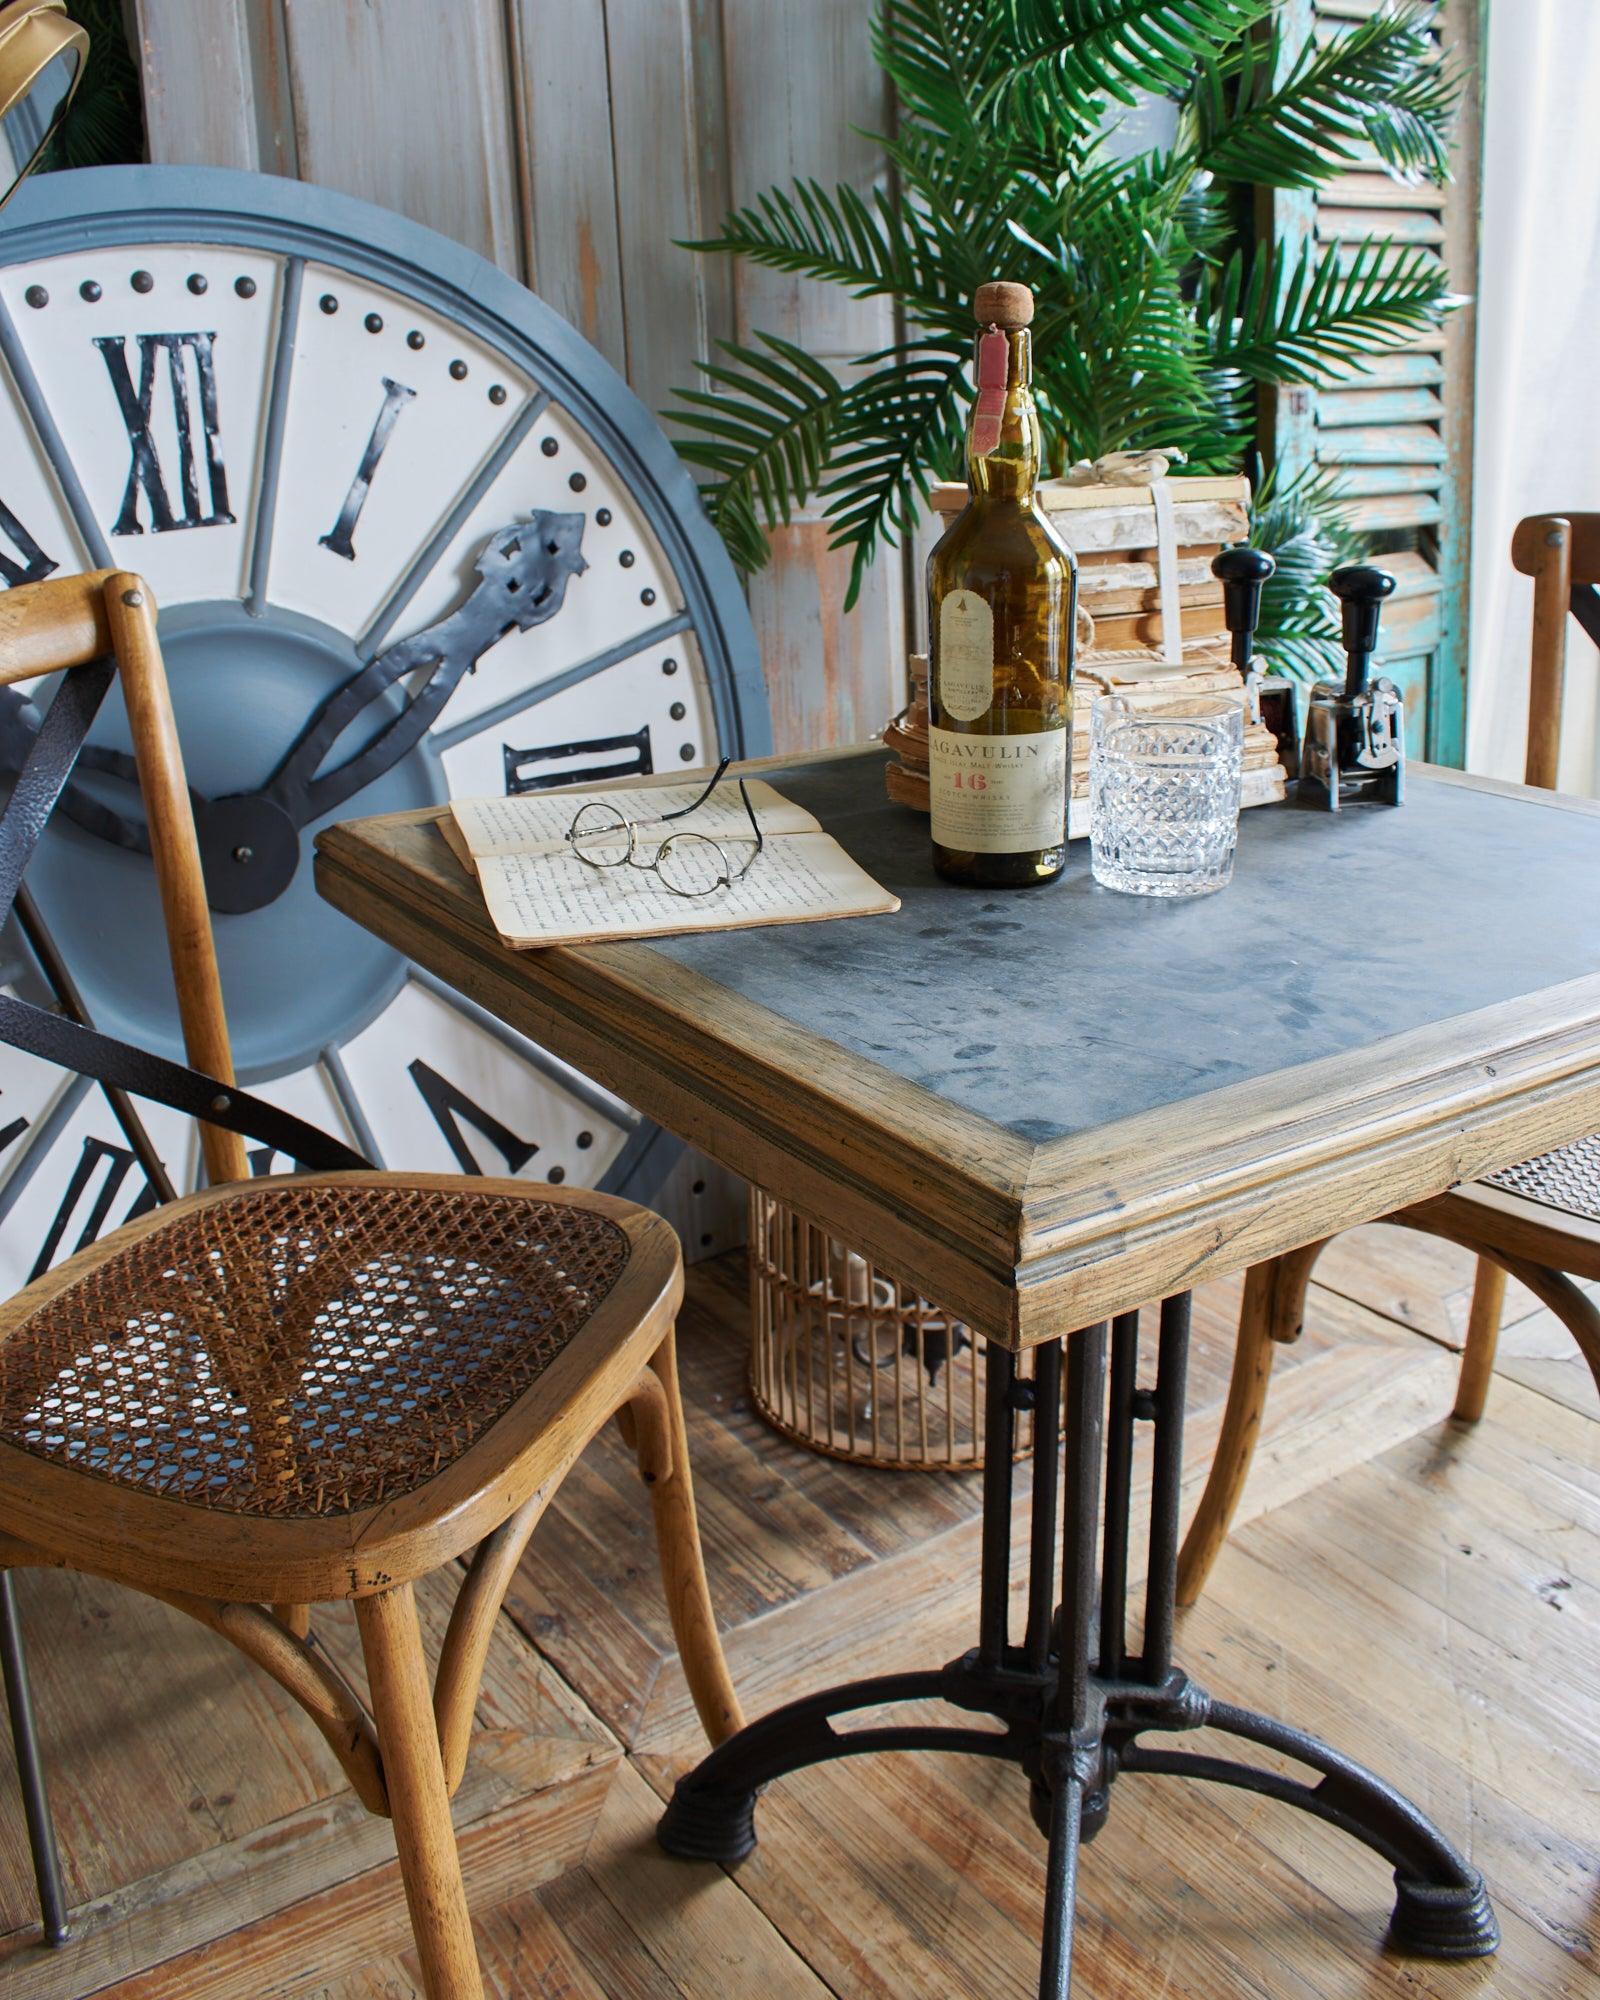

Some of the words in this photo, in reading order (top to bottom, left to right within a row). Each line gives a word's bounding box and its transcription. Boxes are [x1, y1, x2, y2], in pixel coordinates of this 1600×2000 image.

[92, 331, 237, 536] XII
[318, 376, 417, 561] I
[929, 740, 1039, 759] AGAVULIN
[953, 771, 987, 791] 16
[972, 793, 1011, 801] WHISKY
